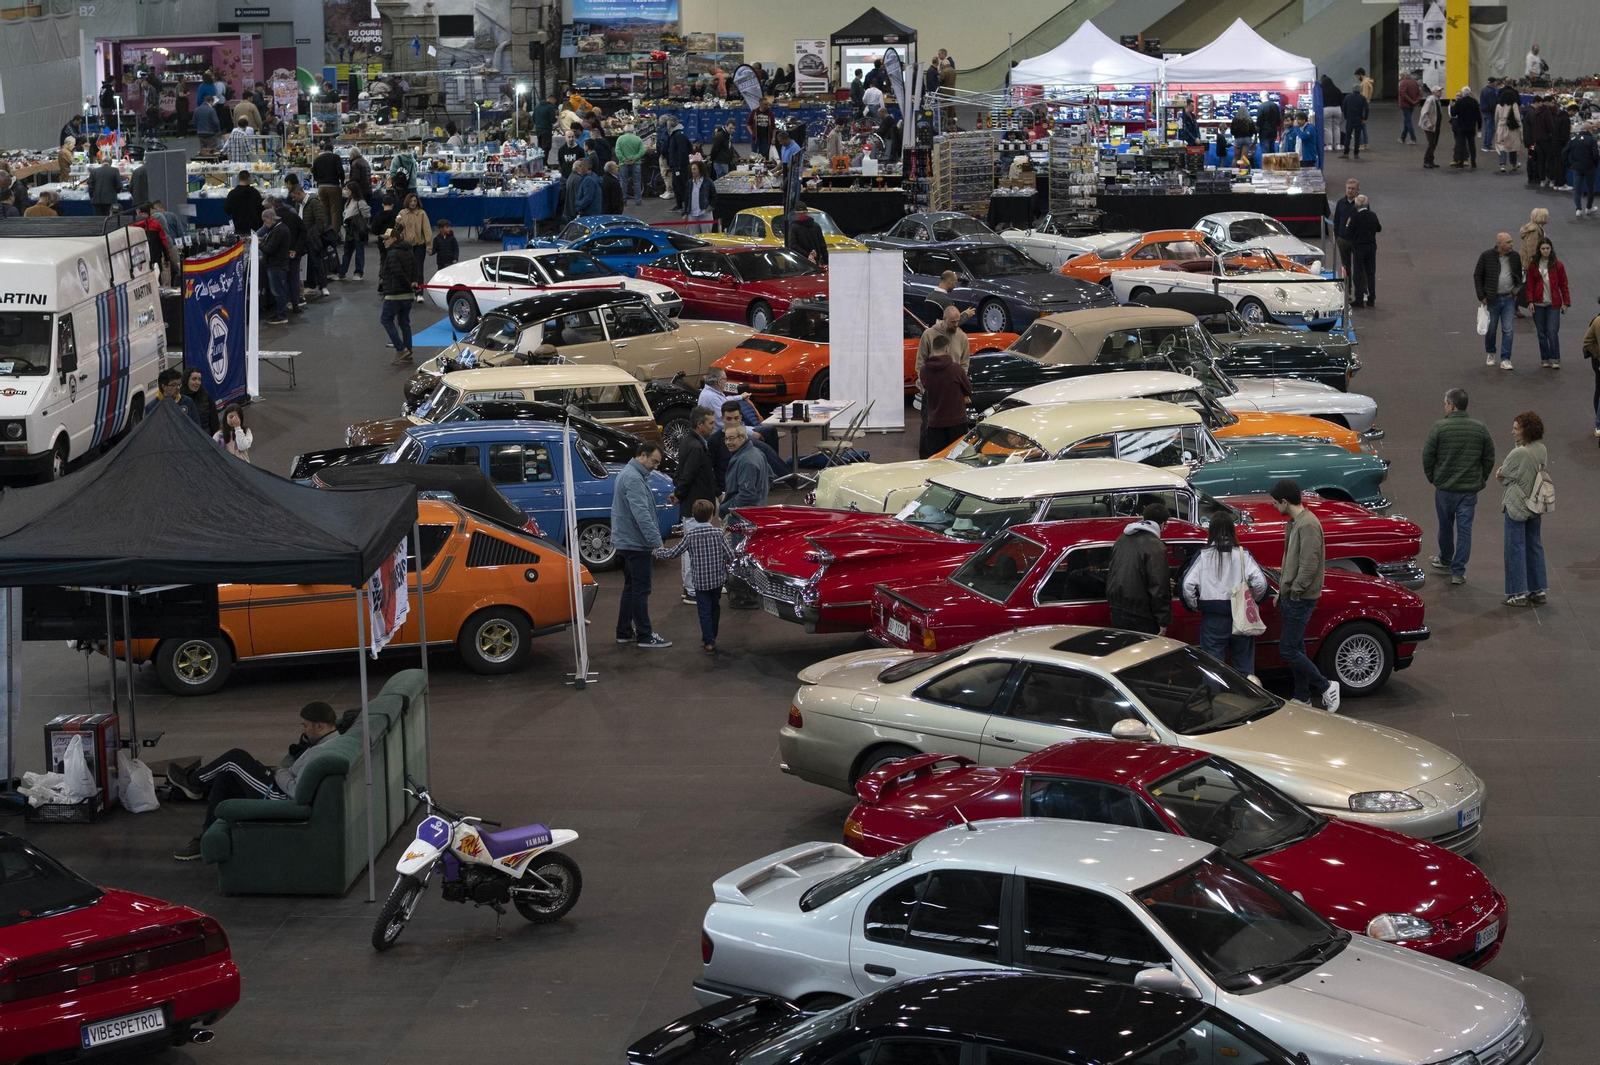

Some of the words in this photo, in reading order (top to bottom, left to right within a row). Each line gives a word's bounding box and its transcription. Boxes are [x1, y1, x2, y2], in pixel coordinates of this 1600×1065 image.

[79, 5, 96, 17] B2
[133, 282, 153, 302] MARTINI
[524, 834, 550, 848] YAMAHA
[90, 1013, 162, 1042] VIBESPETROL
